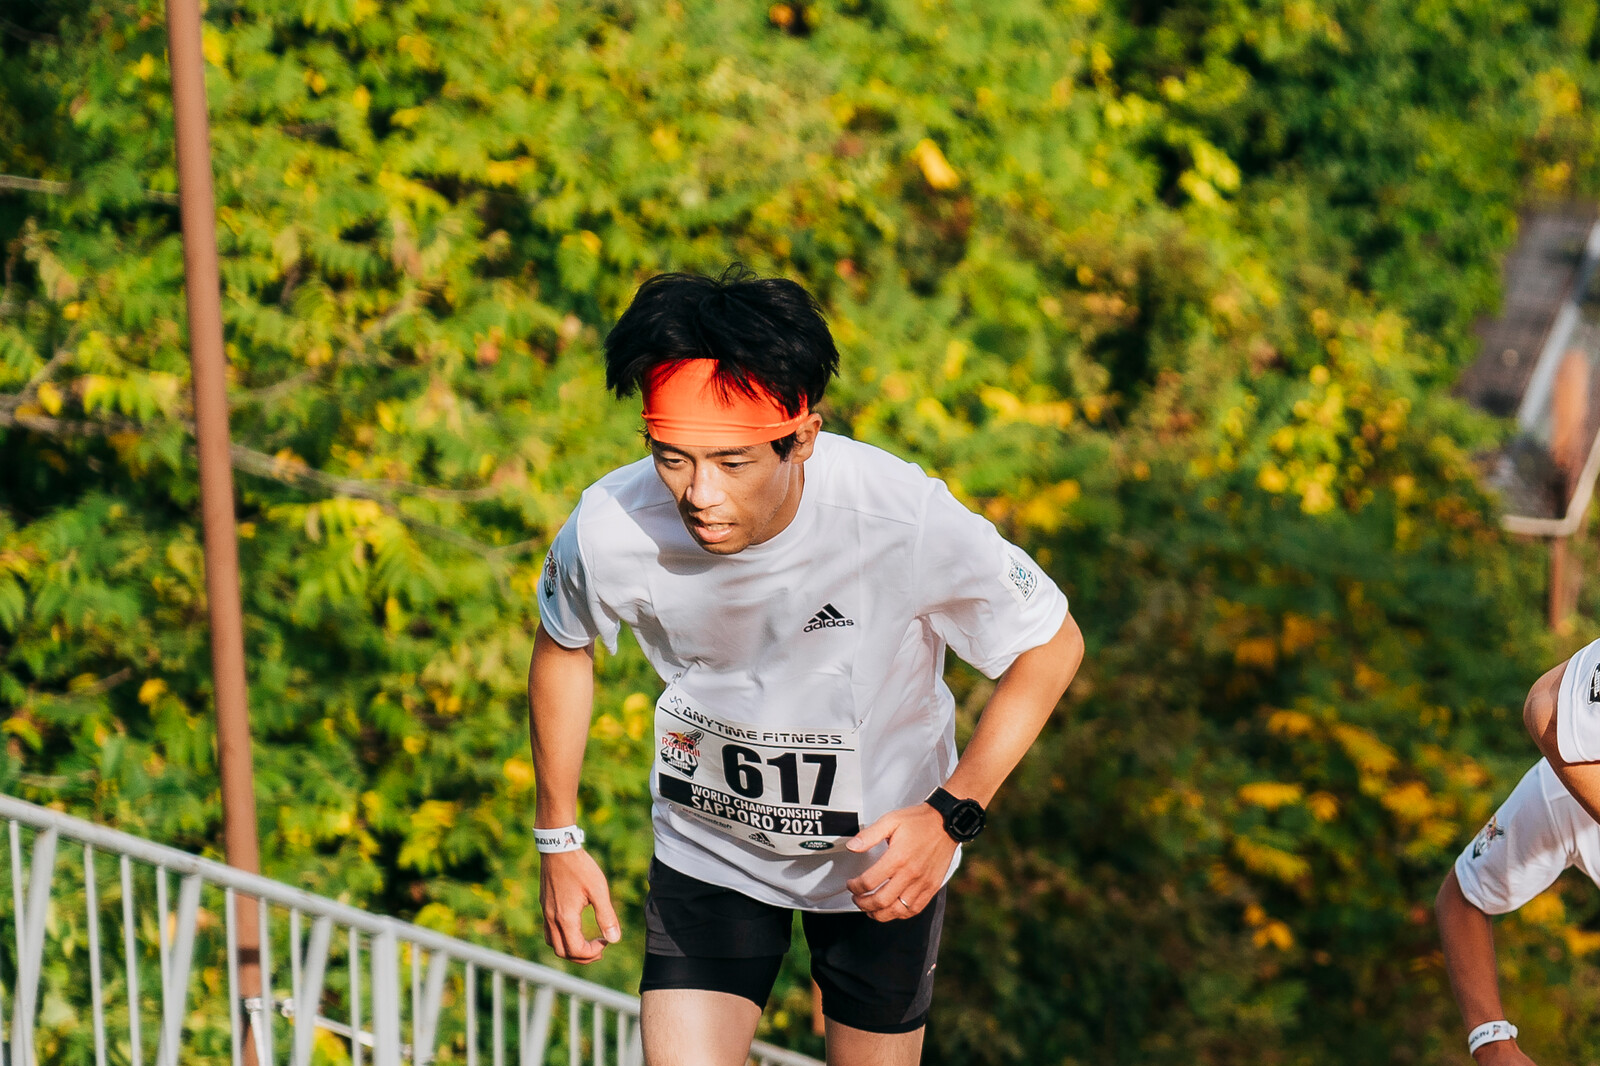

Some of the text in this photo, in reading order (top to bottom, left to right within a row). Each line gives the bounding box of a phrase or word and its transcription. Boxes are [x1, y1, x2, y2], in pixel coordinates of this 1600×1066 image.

[803, 618, 855, 633] adidas
[683, 706, 843, 745] ANYTIME FITNESS
[722, 743, 838, 806] 617
[691, 784, 823, 820] WORLD CHAMPIONSHIP
[691, 795, 823, 835] SAPPORO 2021
